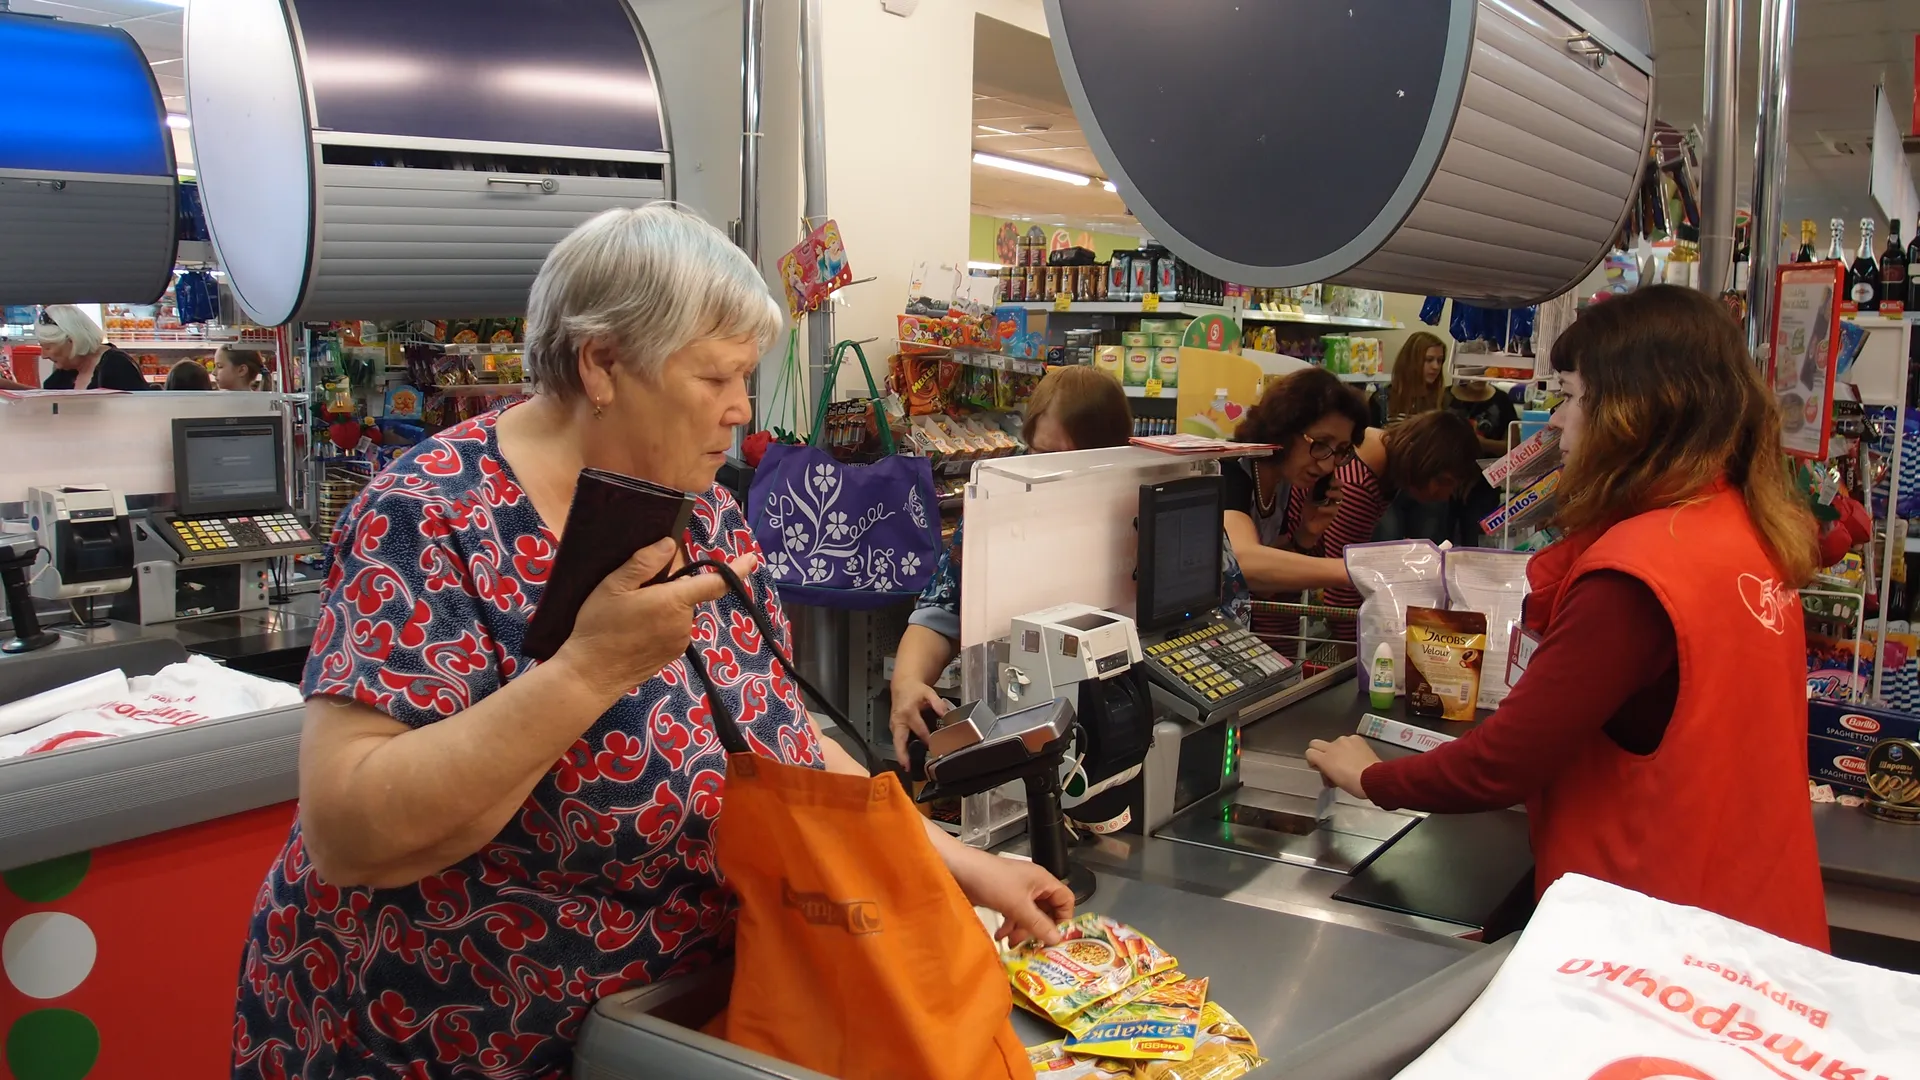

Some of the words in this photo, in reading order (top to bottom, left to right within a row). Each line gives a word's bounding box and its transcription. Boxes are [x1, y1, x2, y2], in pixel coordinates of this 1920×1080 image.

[911, 363, 939, 394] MELLER
[1487, 491, 1539, 530] mentos
[1422, 626, 1466, 645] JACOBS
[1422, 644, 1450, 657] Velour
[1848, 717, 1877, 729] Barilla
[1826, 727, 1878, 742] SPAGHETTONI
[1841, 758, 1867, 770] Barill
[1879, 760, 1913, 771] Шпроты
[1820, 768, 1868, 784] SPAGHETTON
[1682, 954, 1830, 1029] Выручает!
[1141, 1042, 1179, 1050] Maggi
